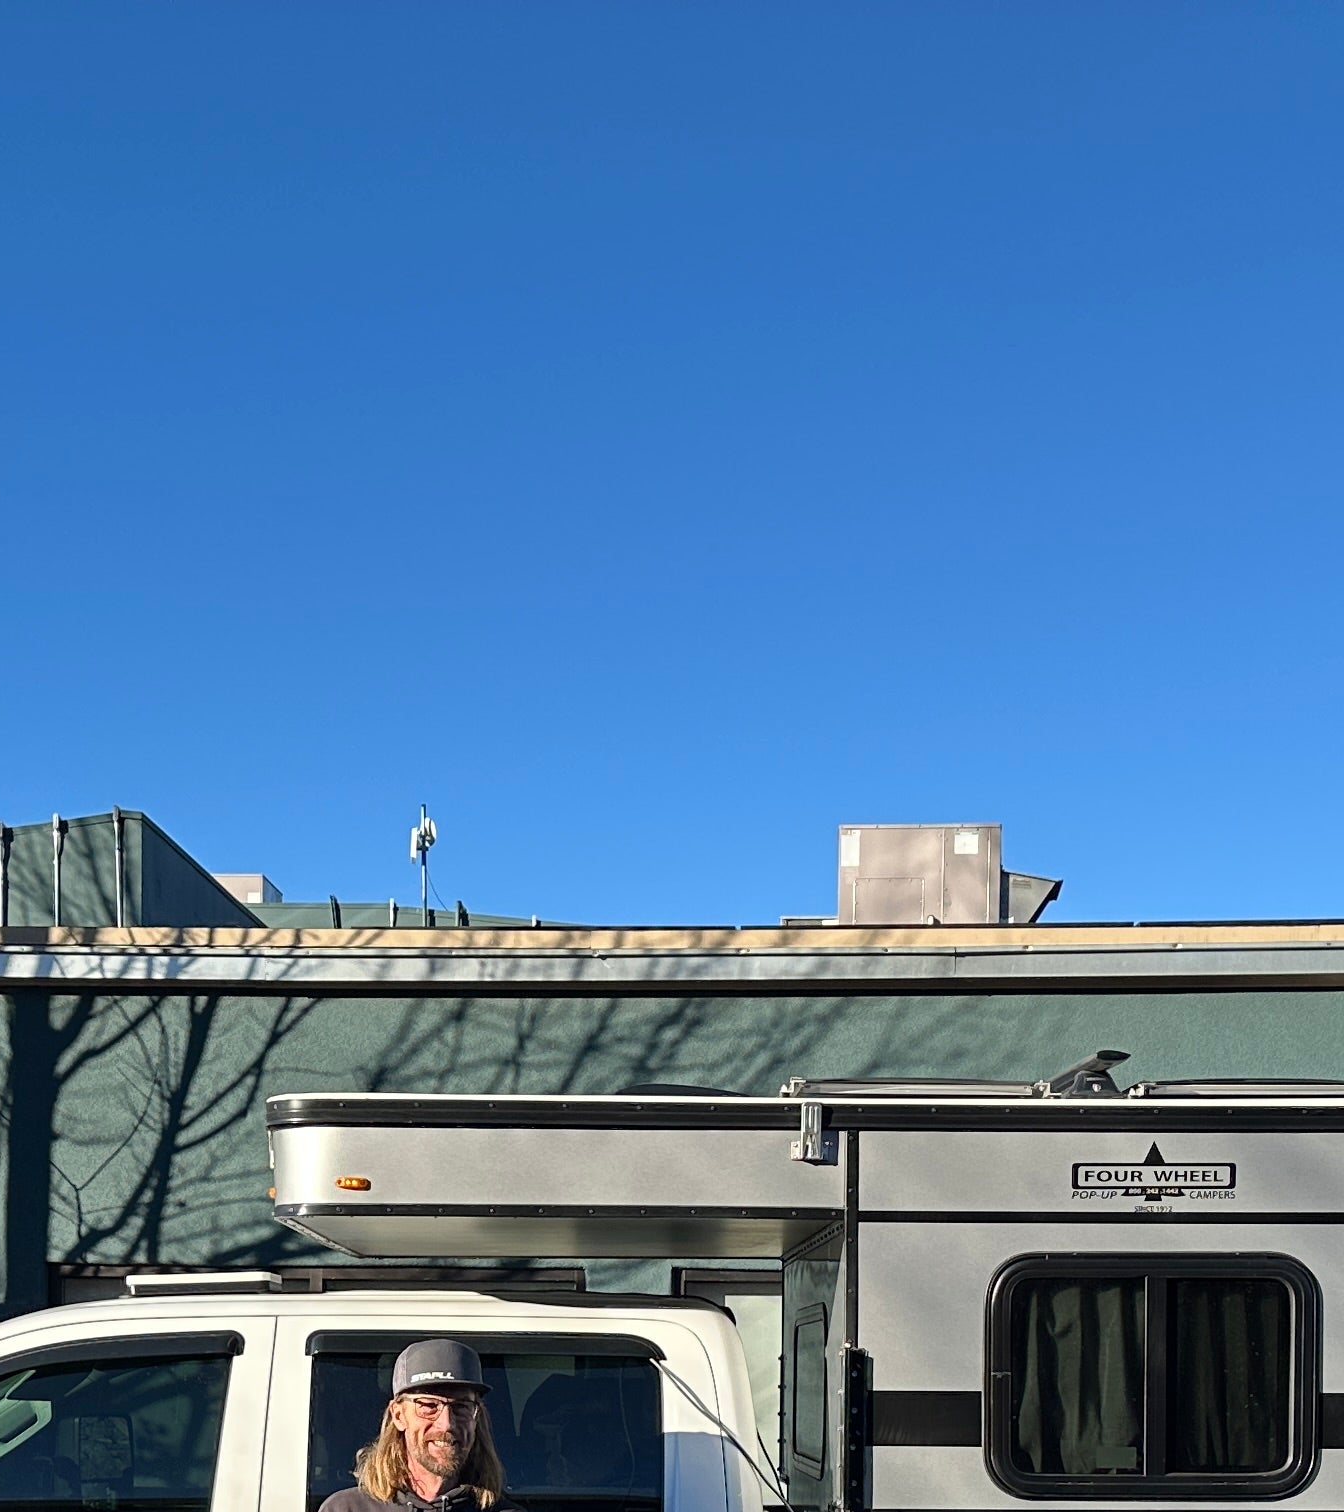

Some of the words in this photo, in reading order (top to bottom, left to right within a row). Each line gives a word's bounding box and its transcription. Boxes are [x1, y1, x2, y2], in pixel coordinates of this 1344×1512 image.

[1084, 1170, 1143, 1182] FOUR
[1154, 1170, 1224, 1182] WHEEL
[1071, 1190, 1118, 1200] POP-UP
[1189, 1190, 1236, 1200] CAMPERS
